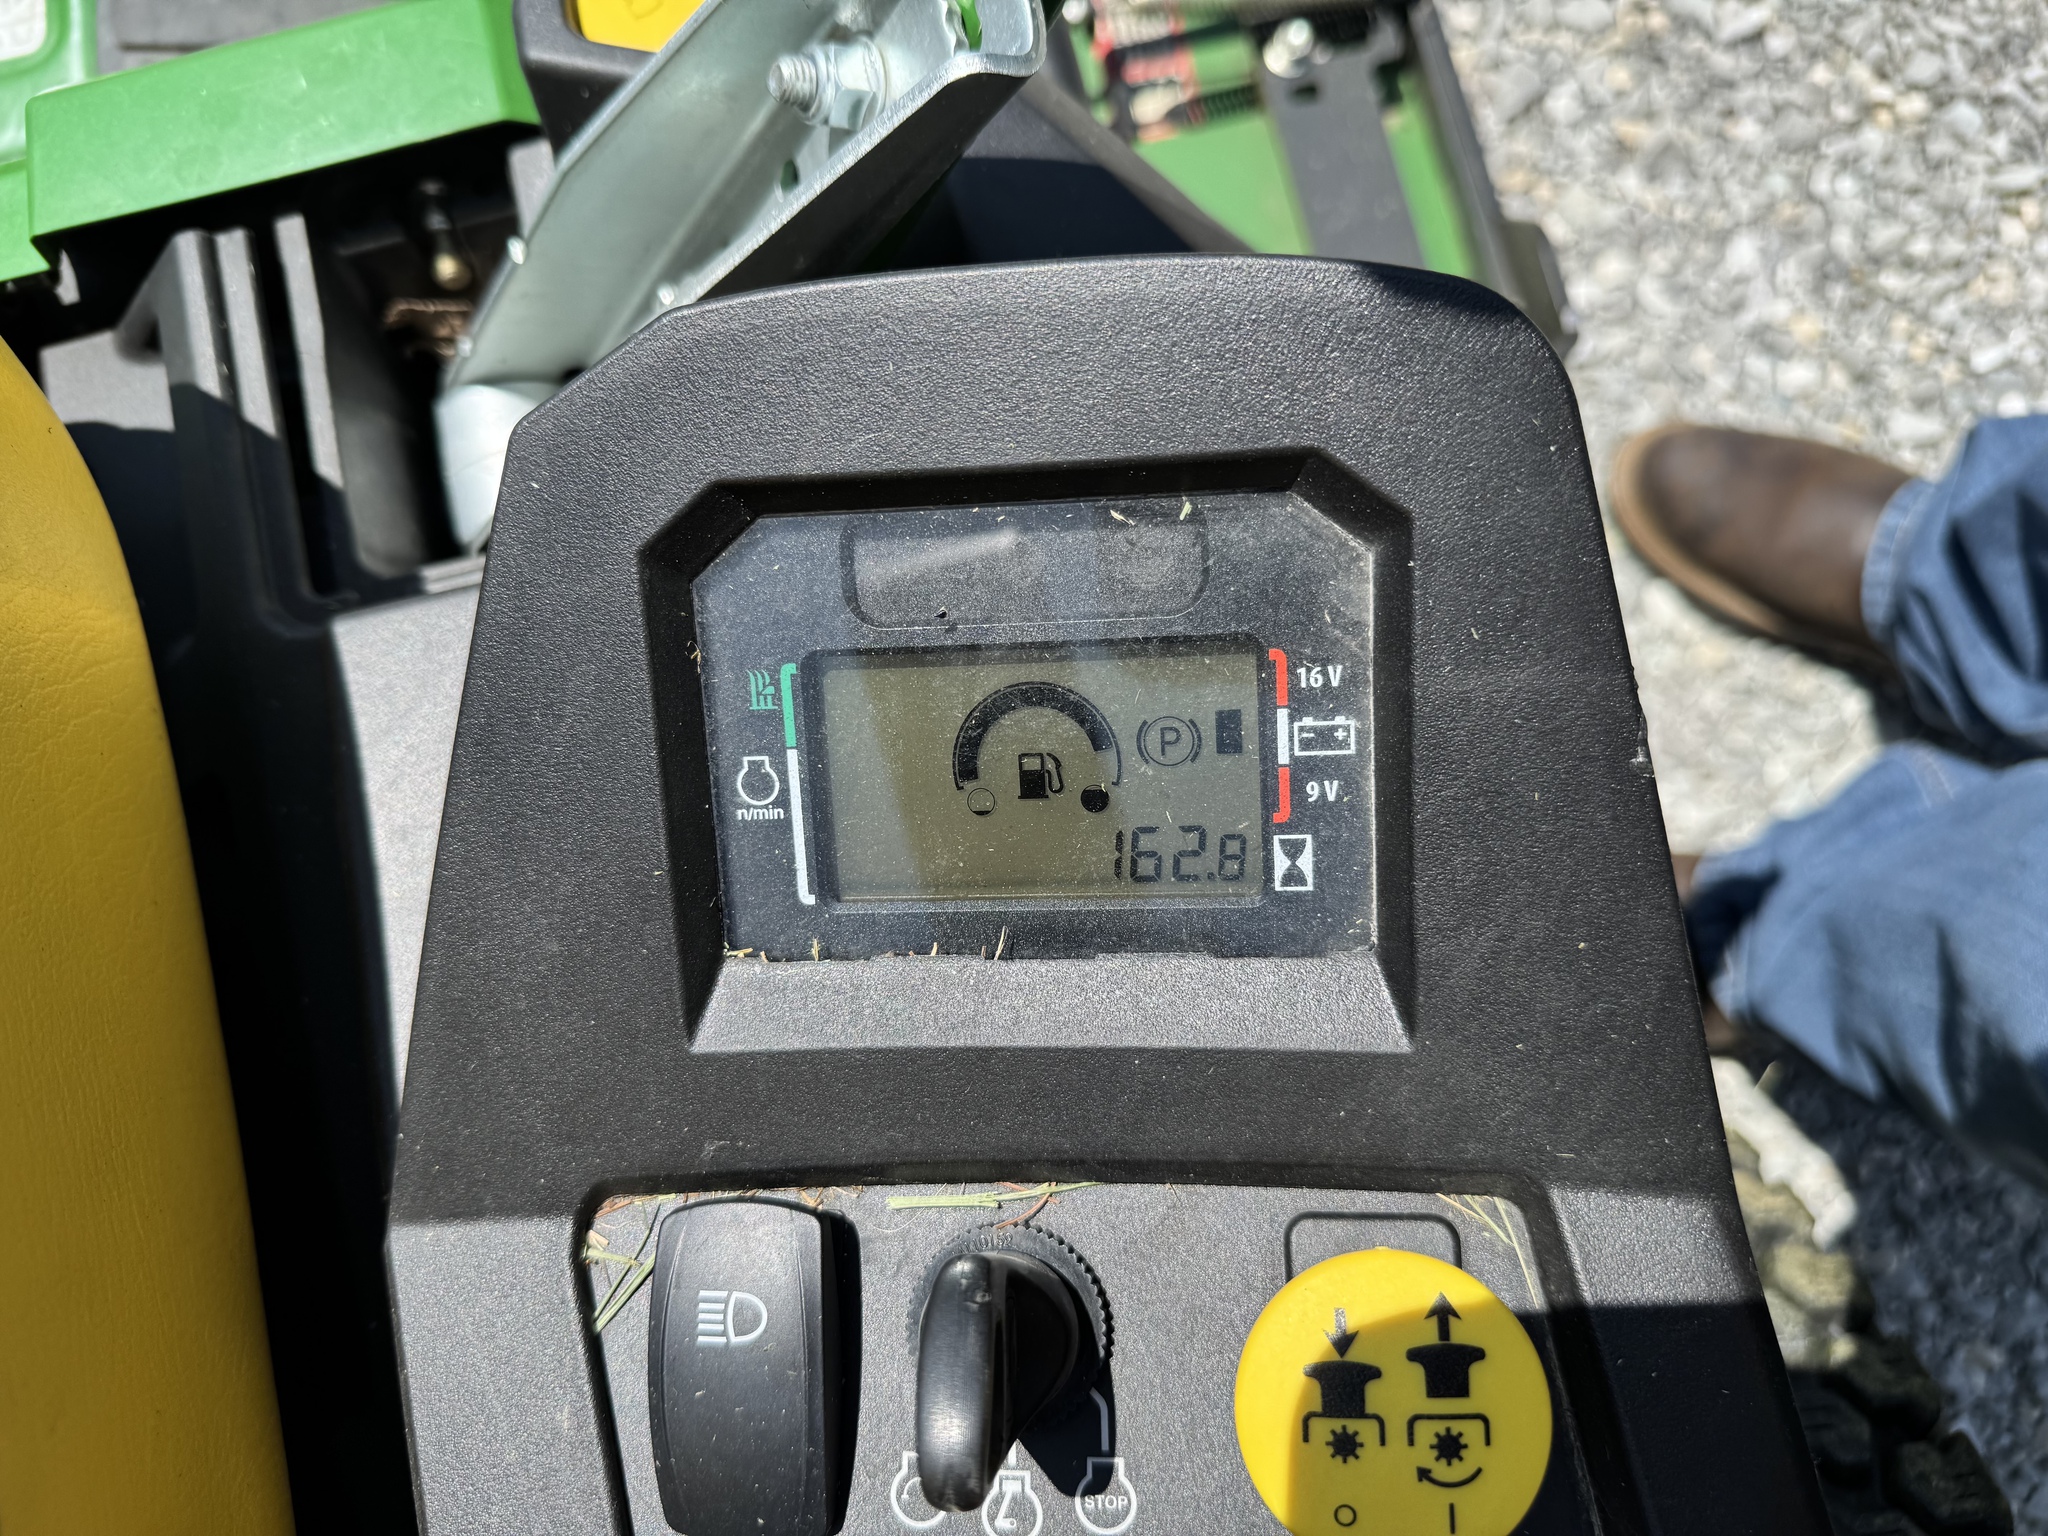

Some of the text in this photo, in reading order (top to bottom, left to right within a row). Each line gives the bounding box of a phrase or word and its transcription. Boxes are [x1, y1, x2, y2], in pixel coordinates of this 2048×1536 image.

[736, 804, 785, 821] n/min
[1113, 824, 1248, 883] 162.8
[1084, 1494, 1129, 1511] STOP
